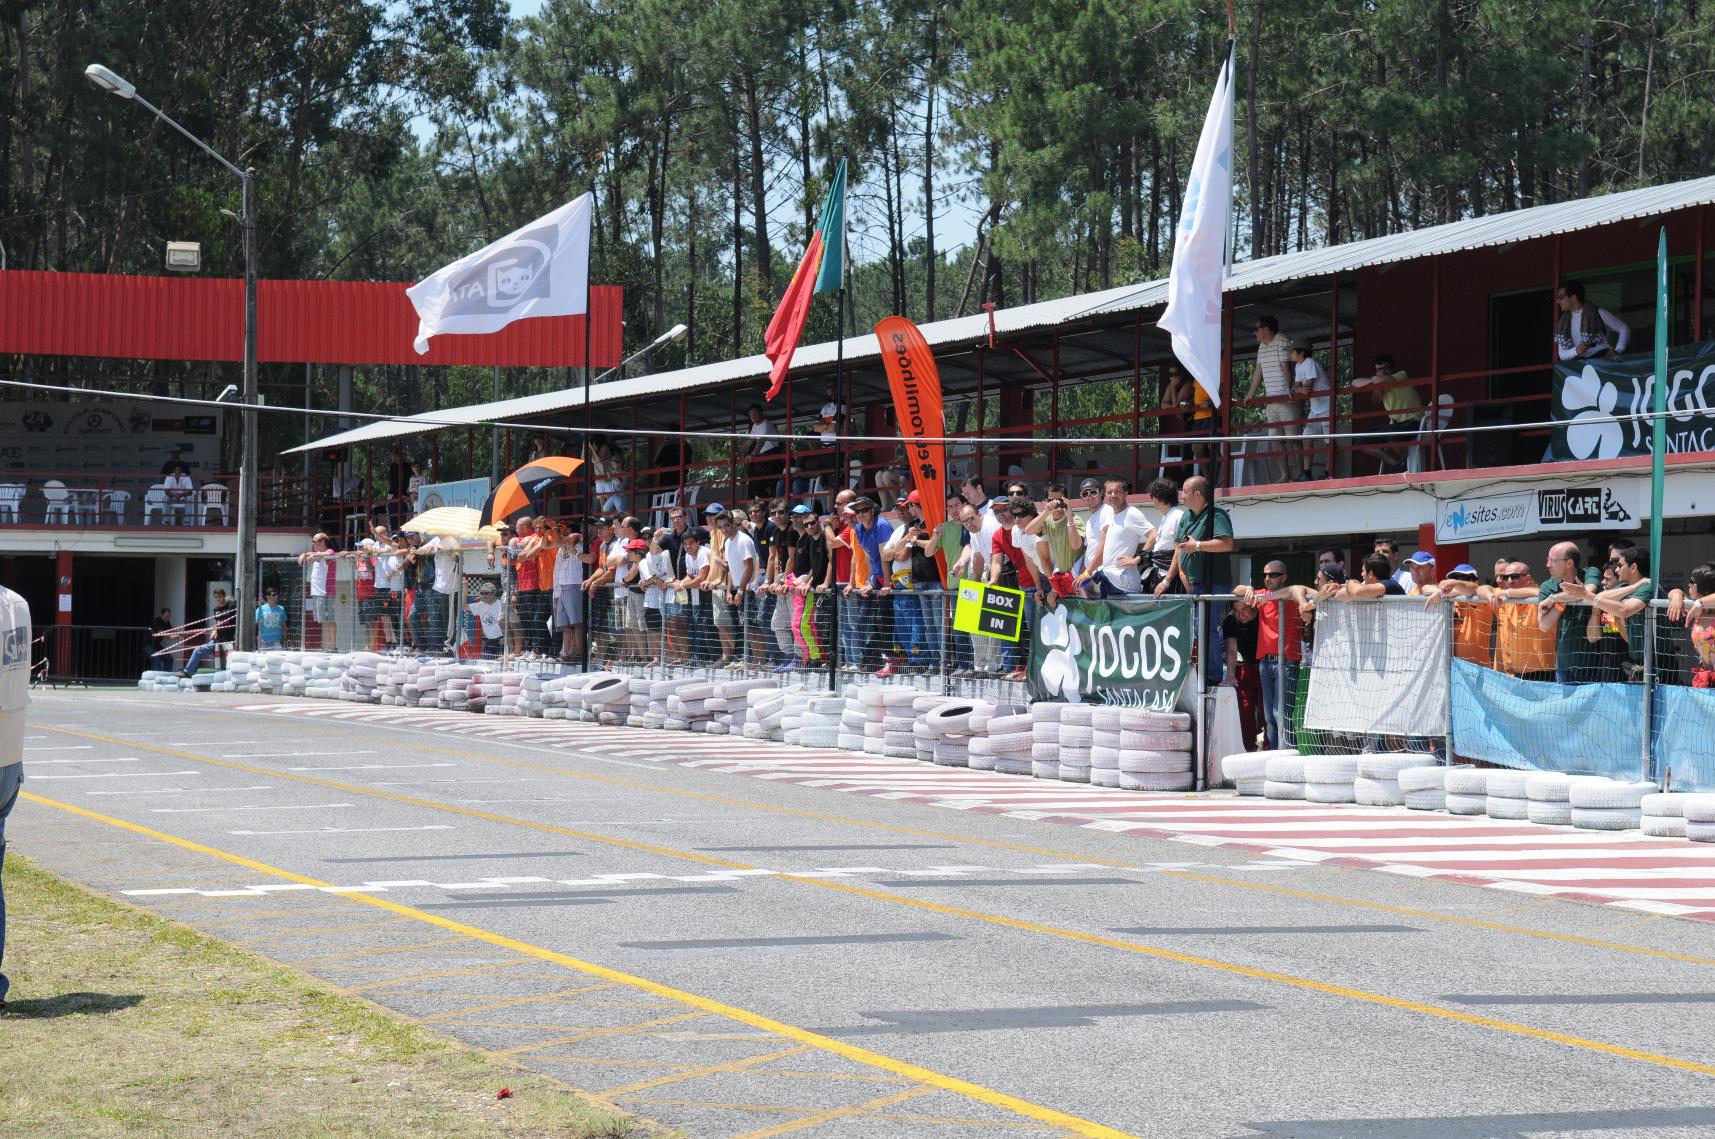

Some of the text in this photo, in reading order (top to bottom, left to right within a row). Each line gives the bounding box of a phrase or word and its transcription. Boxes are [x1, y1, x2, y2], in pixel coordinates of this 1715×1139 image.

[1645, 427, 1715, 456] SNTAC
[1538, 489, 1566, 524] VIRUS
[986, 593, 1014, 608] BOX
[990, 617, 1005, 630] IN
[1086, 624, 1181, 694] JOGOS
